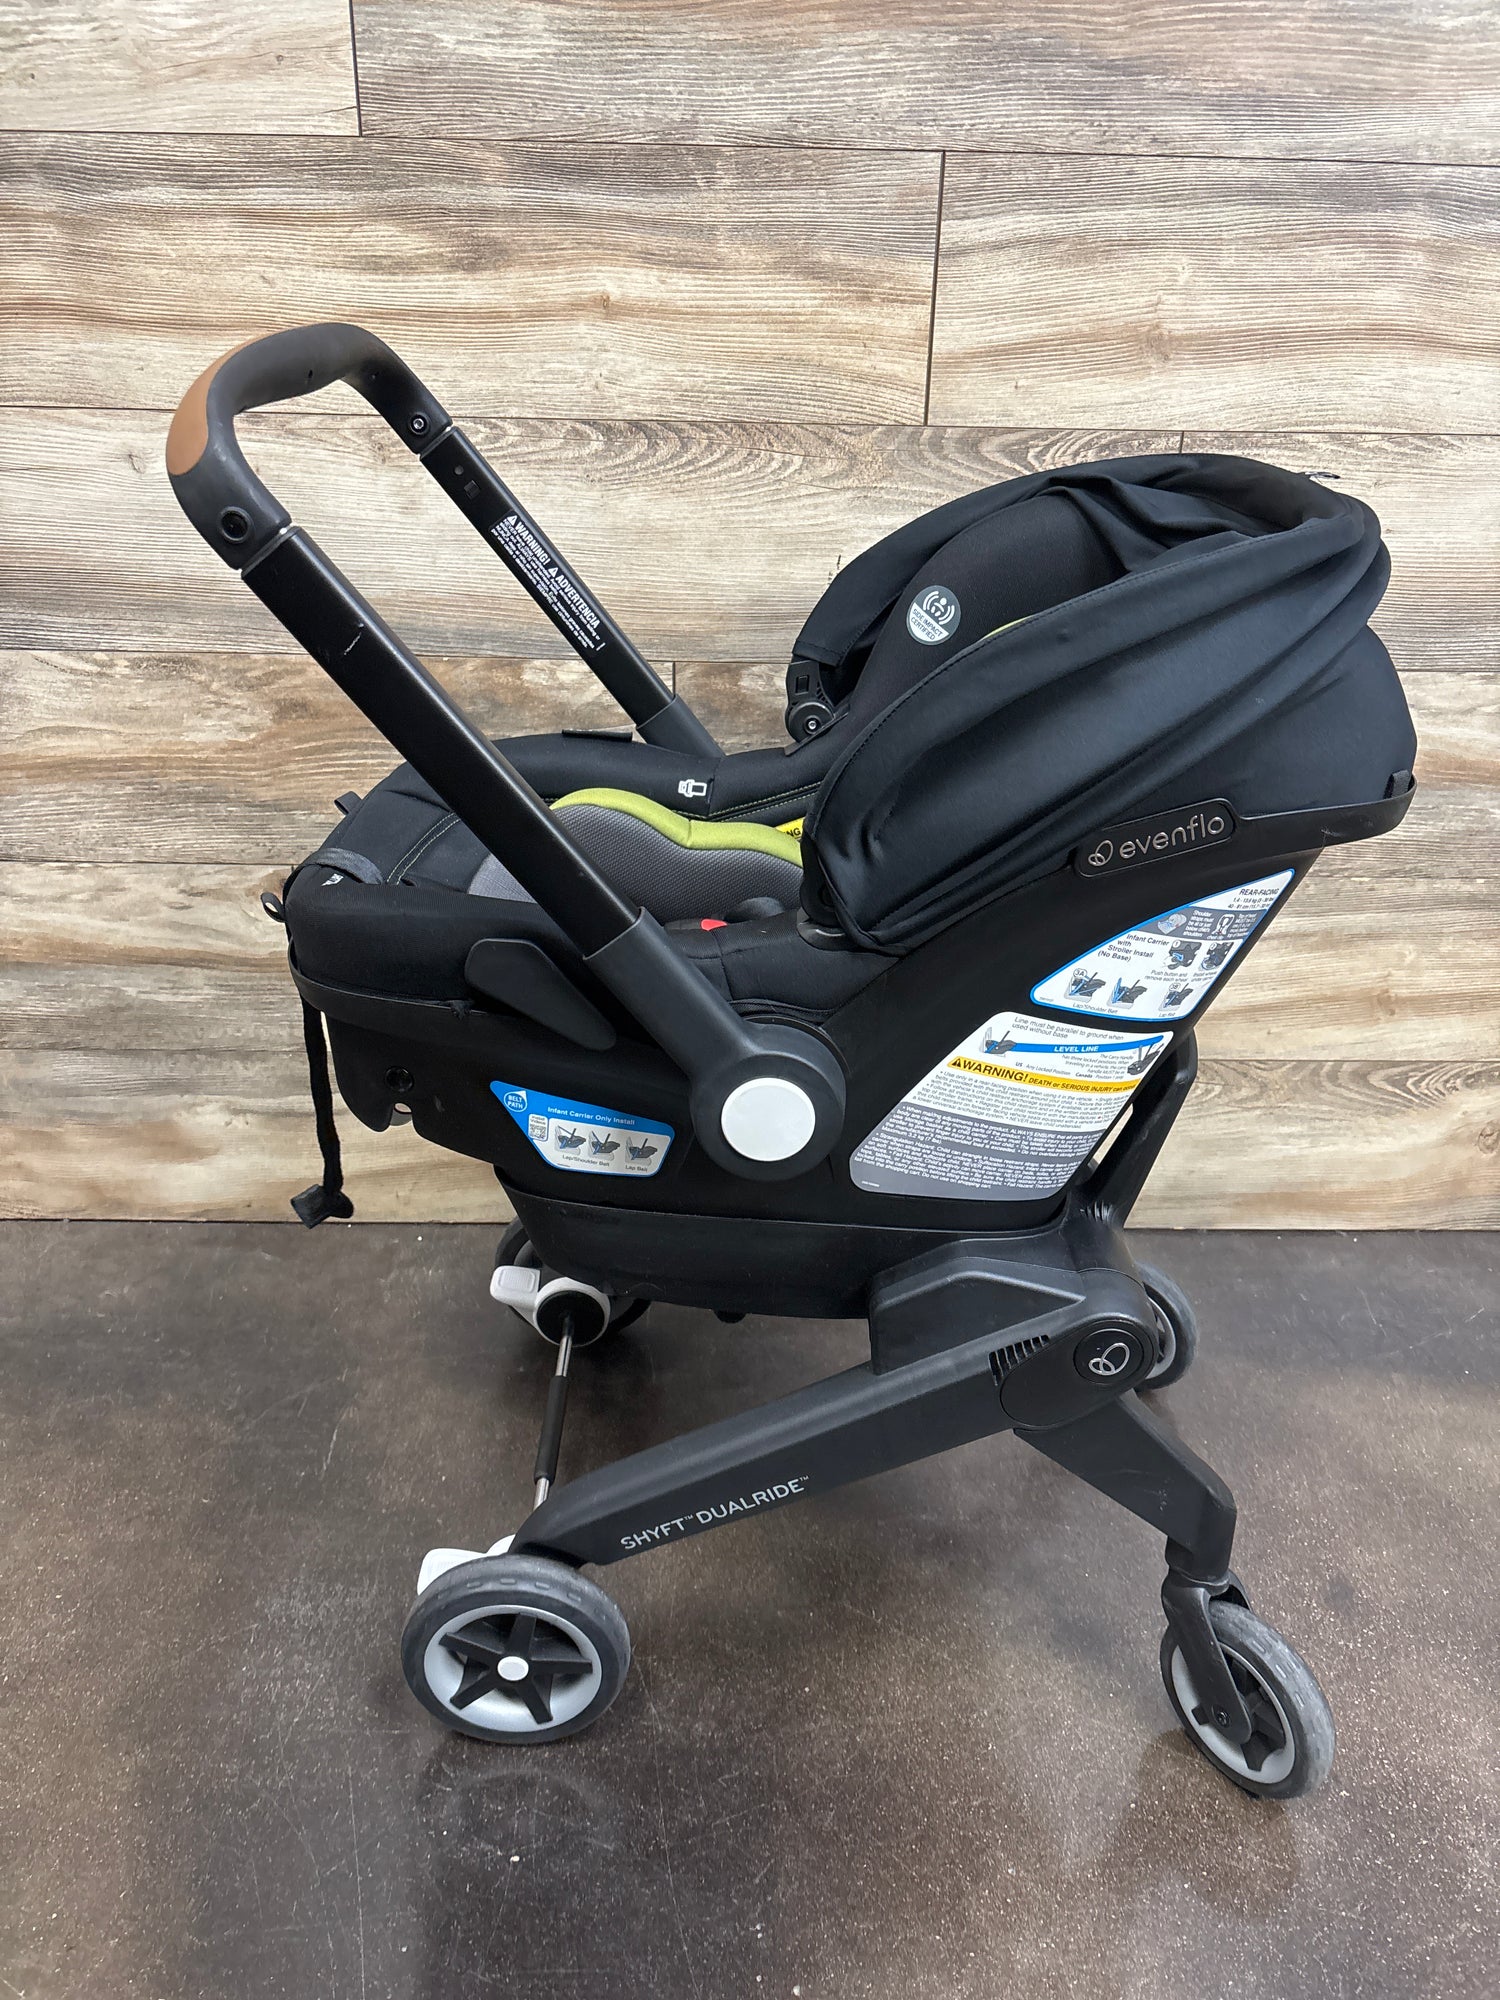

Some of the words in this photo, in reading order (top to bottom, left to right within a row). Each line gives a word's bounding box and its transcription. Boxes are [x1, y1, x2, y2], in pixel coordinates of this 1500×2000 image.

[515, 522, 551, 565] WARNING!
[555, 574, 601, 628] ADVERTENCIA
[911, 617, 936, 640] CERTIFIED
[912, 608, 923, 622] SIDE
[923, 617, 943, 637] IMPACT
[1119, 813, 1225, 859] evenflo
[1126, 933, 1147, 943] Infant
[1147, 937, 1170, 946] Carrier
[1097, 950, 1110, 958] (No
[1112, 953, 1132, 962] Base)
[1107, 944, 1132, 954] Stroller
[1133, 949, 1154, 958] Install
[1073, 1002, 1106, 1012] Lap/Shoulder
[1012, 1023, 1028, 1031] used
[1029, 1026, 1052, 1036] without
[1052, 1030, 1068, 1038] base
[1014, 1016, 1028, 1024] Line
[1029, 1020, 1046, 1028] must
[1055, 1026, 1079, 1035] parallel
[1086, 1032, 1108, 1040] ground
[963, 1060, 1029, 1082] WARNING!
[1028, 1077, 1052, 1087] DEATH
[1061, 1082, 1090, 1092] SERIOUS
[1036, 1065, 1053, 1073] Locked
[507, 1094, 522, 1103] BELT
[507, 1101, 523, 1109] PATH
[547, 1106, 568, 1116] Infant
[569, 1110, 593, 1120] Carrier
[595, 1114, 612, 1123] Only
[613, 1116, 635, 1125] Install
[906, 1106, 922, 1114] When
[1010, 1128, 1034, 1136] ALWAYS
[881, 1125, 908, 1136] Maximum
[562, 1154, 598, 1165] Lap/Shoulder
[598, 1159, 610, 1167] Belt
